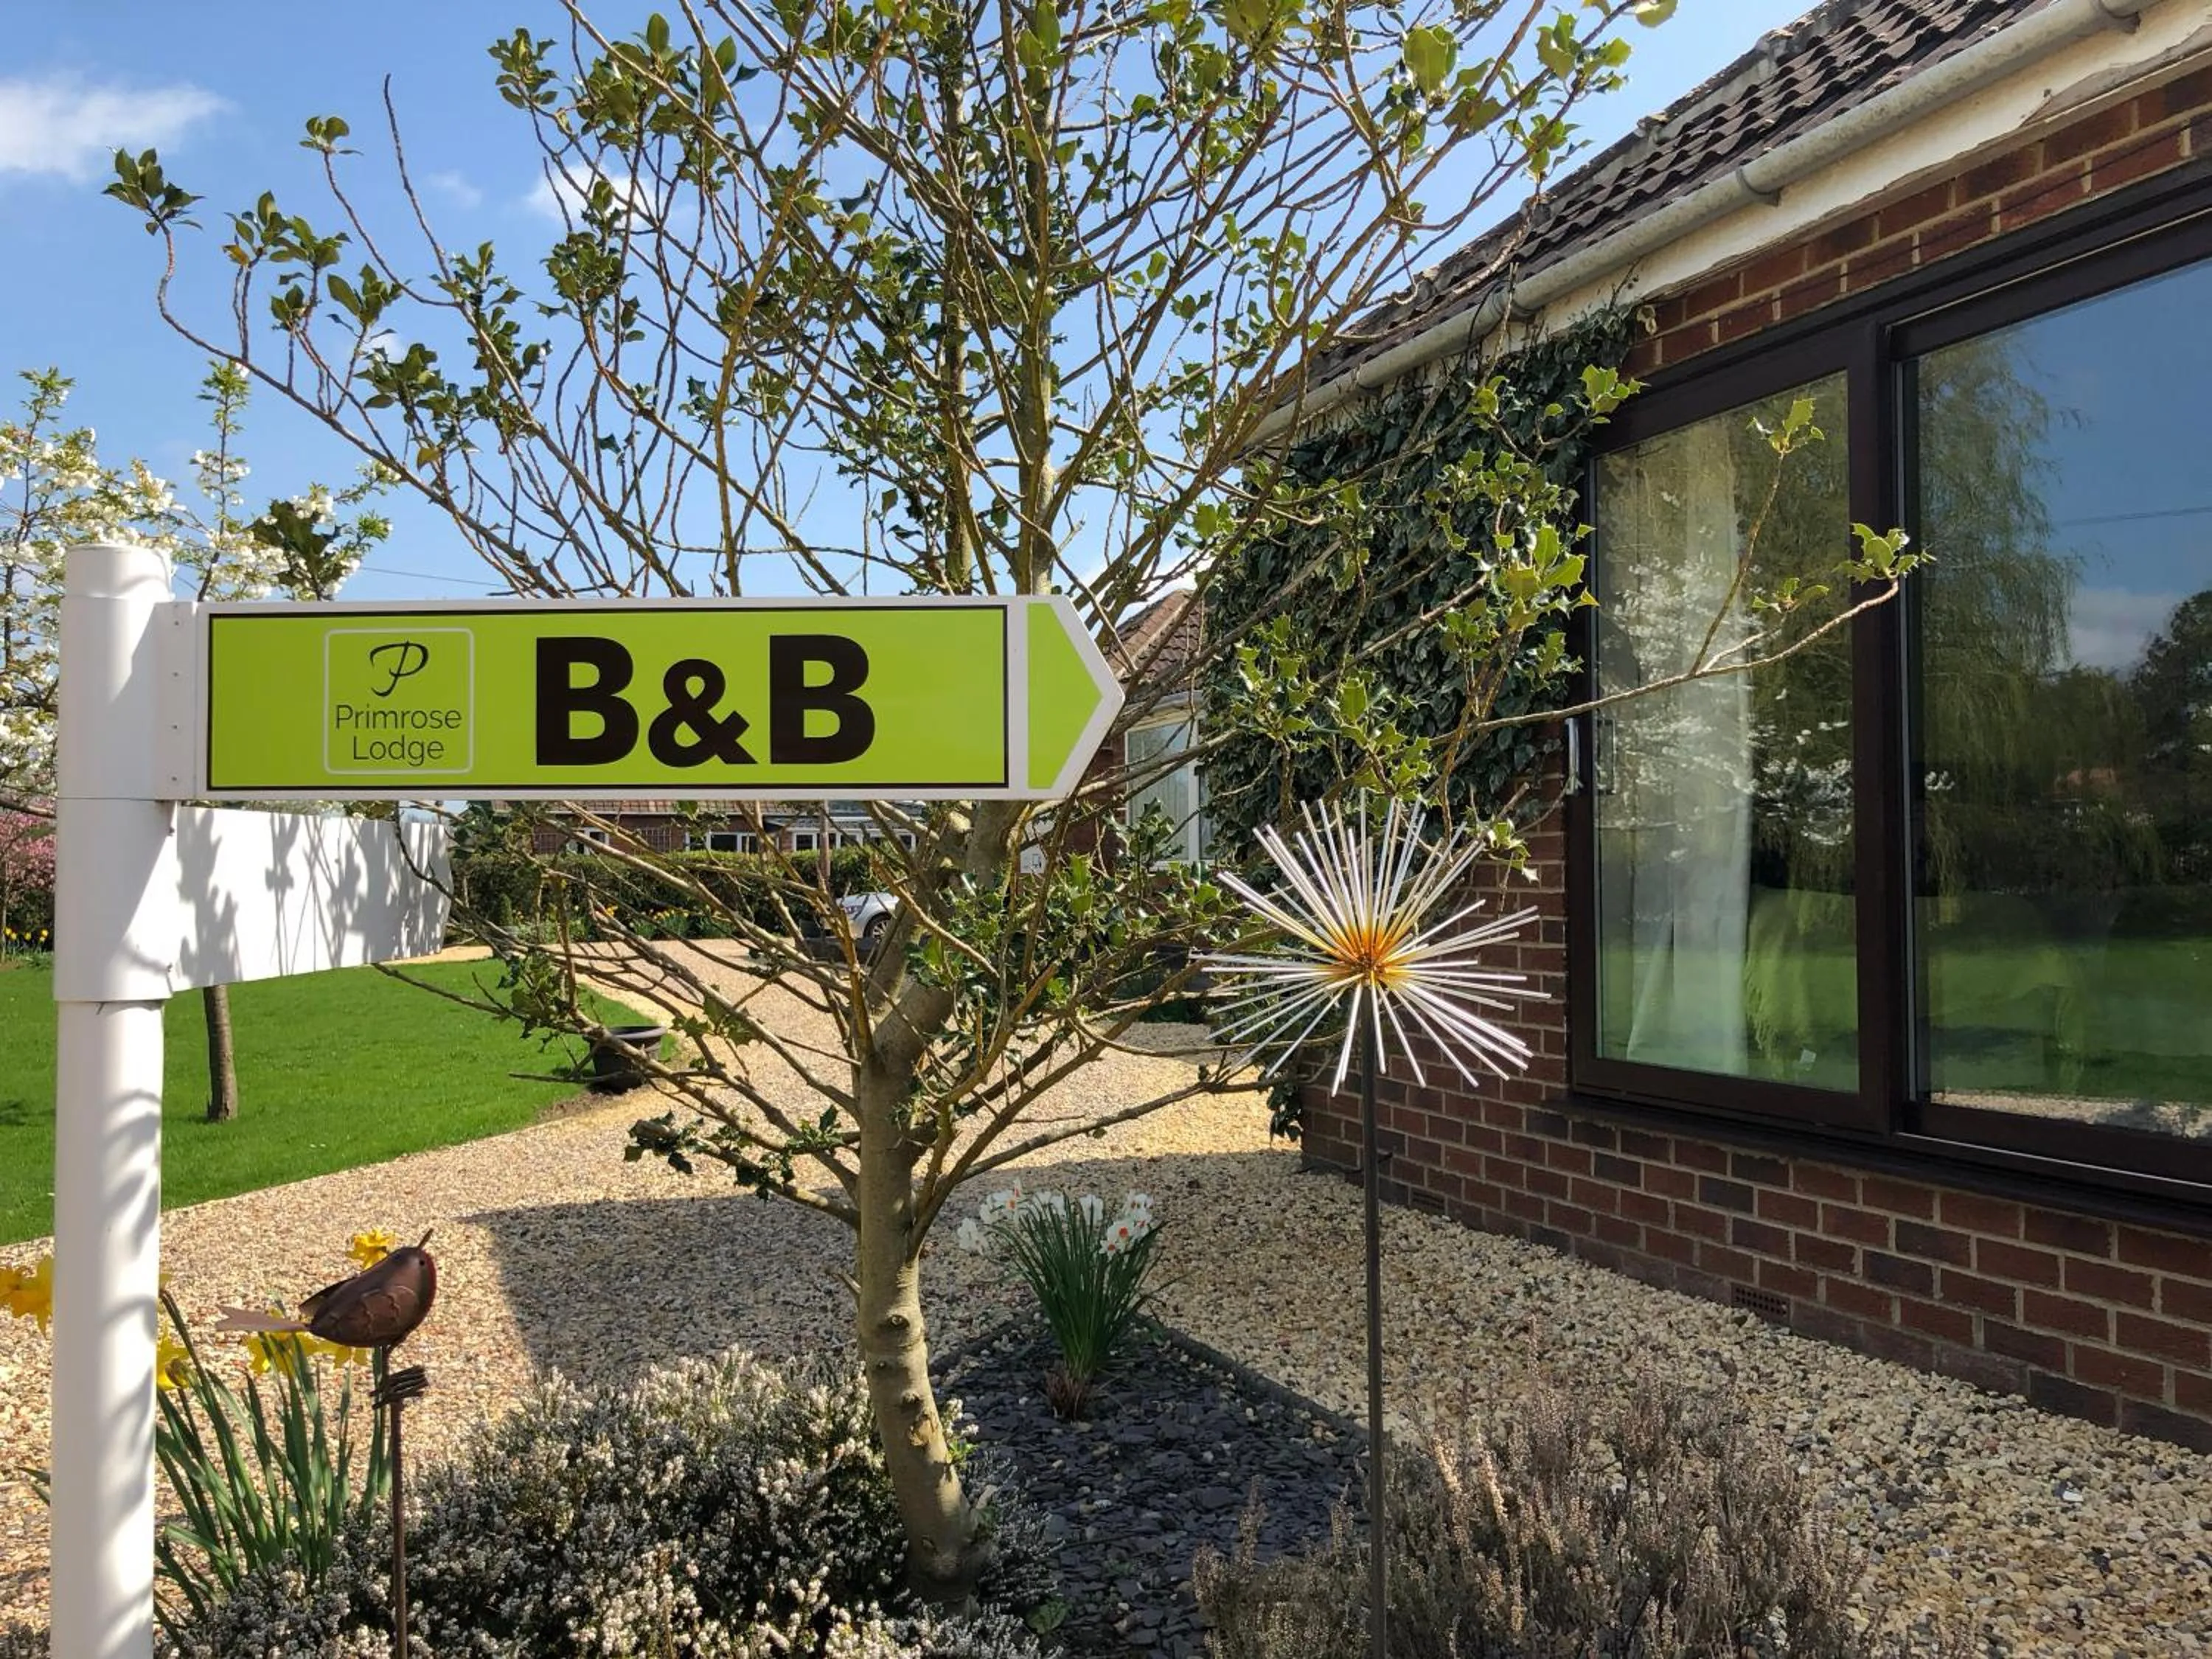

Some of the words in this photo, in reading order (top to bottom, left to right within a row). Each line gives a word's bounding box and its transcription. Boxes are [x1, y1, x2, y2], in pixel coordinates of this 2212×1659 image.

[369, 640, 429, 697] P
[335, 703, 462, 729] Primrose
[536, 634, 875, 768] B&B
[353, 734, 444, 767] Lodge
